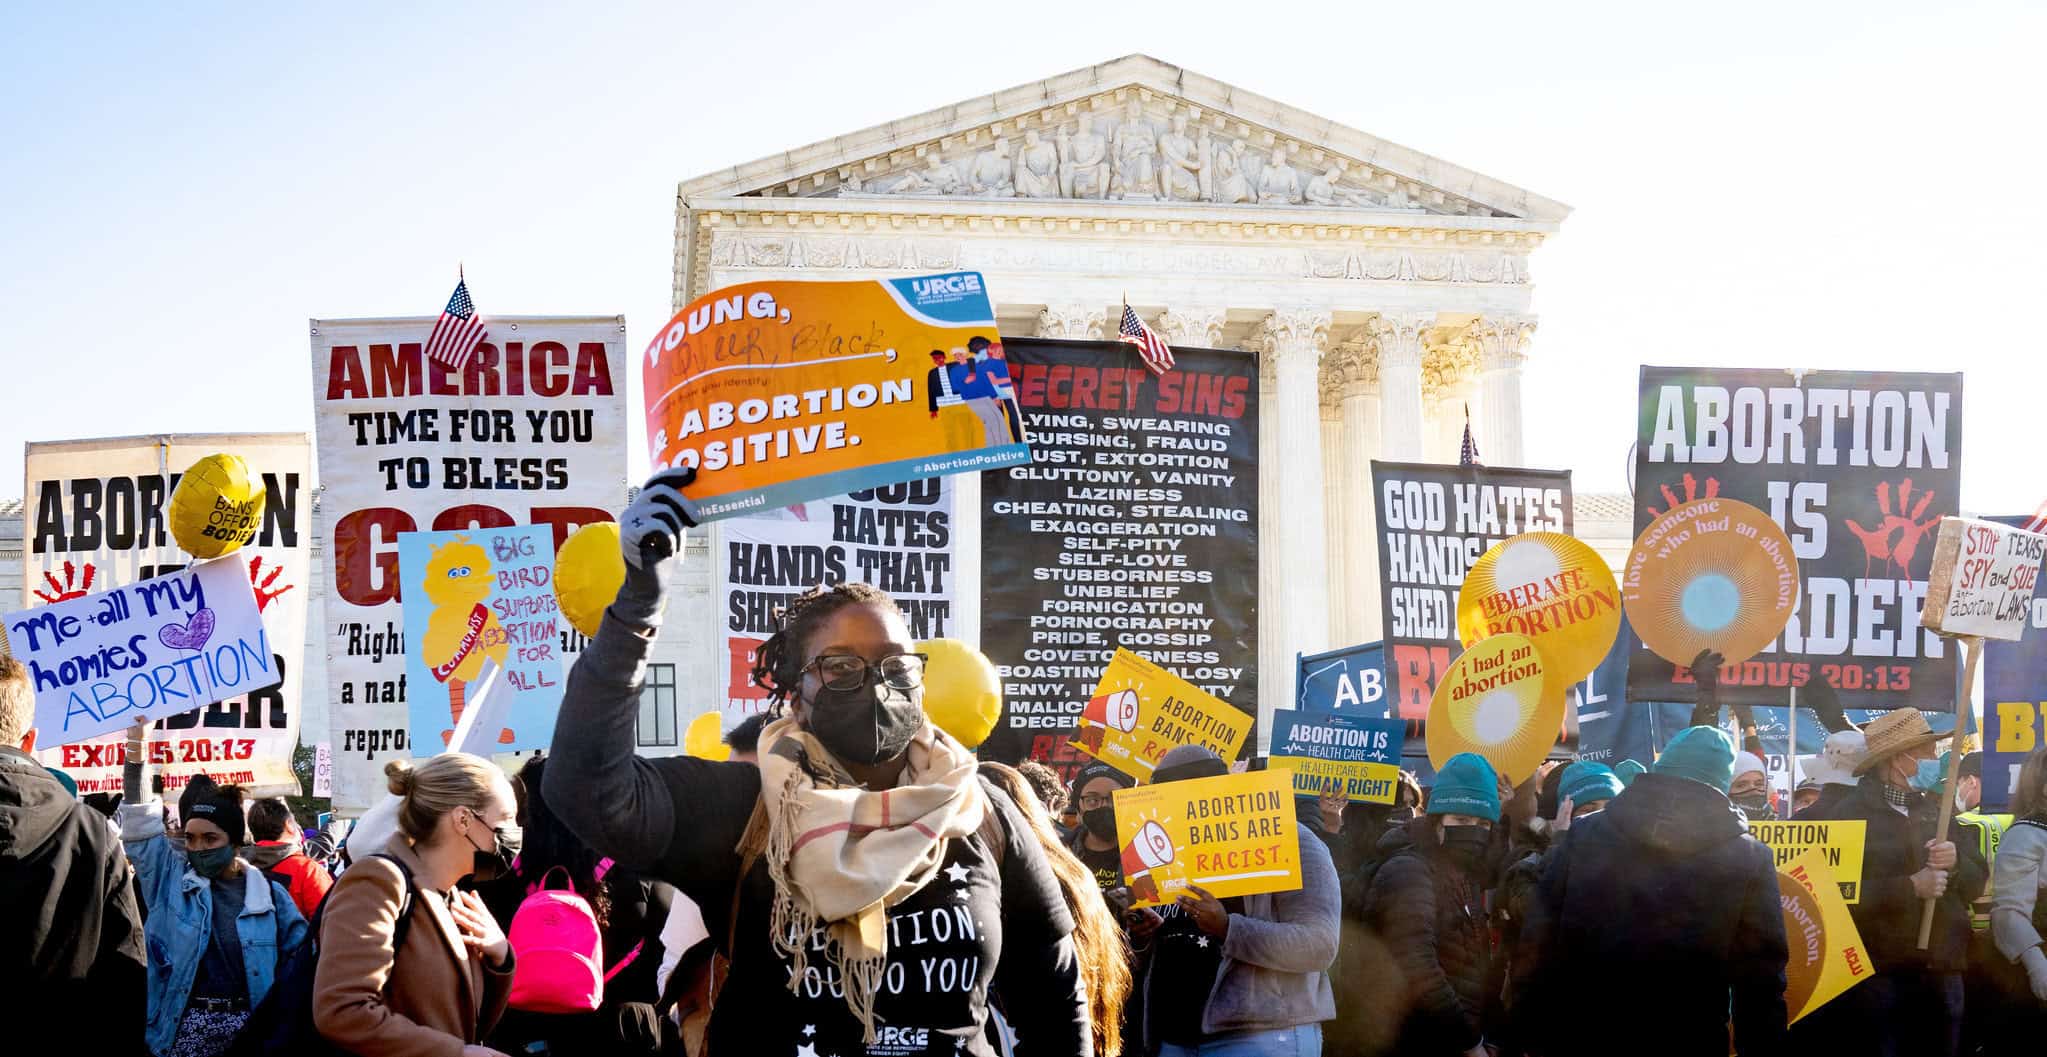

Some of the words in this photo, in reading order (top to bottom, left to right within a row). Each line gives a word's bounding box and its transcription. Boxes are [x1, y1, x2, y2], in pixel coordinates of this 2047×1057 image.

[912, 274, 981, 297] URGE
[650, 292, 793, 368] YOUNG,
[791, 320, 885, 356] Black
[678, 378, 913, 441] ABORTION
[1156, 371, 1250, 419] SINS
[349, 408, 440, 446] TIME
[449, 409, 516, 443] FOR
[526, 409, 594, 443] YOU
[1102, 417, 1231, 437] SWEARING
[1647, 385, 1950, 469] ABORTION
[655, 421, 863, 473] OSITIVE.
[1025, 432, 1137, 450] CURSING,
[1147, 436, 1228, 452] FRAUD
[379, 457, 431, 491] TO
[442, 457, 569, 490] BLESS
[913, 450, 1026, 474] #AbortionPositive
[1031, 450, 1088, 466] UST,
[1094, 452, 1230, 470] EXTORTION
[1009, 467, 1142, 486] GLUTTONY,
[1151, 471, 1236, 488] VANITY
[214, 495, 255, 515] BANS
[1067, 486, 1183, 502] LAZINESS
[1383, 479, 1447, 533] GOD
[1453, 483, 1565, 536] HATES
[33, 473, 300, 554] ABORN
[833, 503, 950, 549] HATES
[992, 501, 1124, 520] CHEATING,
[1131, 504, 1249, 523] STEALING
[1767, 481, 1828, 560] IS
[1030, 520, 1217, 538] EXAGGERATION
[1655, 529, 1691, 560] who
[1695, 516, 1730, 534] had
[1735, 521, 1758, 540] an
[1966, 525, 2001, 556] STOP
[2007, 532, 2044, 561] TEXAS
[491, 535, 535, 563] BIG
[1063, 536, 1183, 552] SELF-PITY
[1624, 552, 1648, 588] love
[1644, 500, 1720, 548] someone
[728, 541, 847, 587] HANDS
[856, 547, 951, 594] THAT
[1058, 552, 1188, 568] SELF-LOVE
[1386, 532, 1481, 586] HANDS
[497, 564, 550, 592] BIRD
[1033, 567, 1214, 584] STUBBORNESS
[1960, 558, 1995, 590] SPY
[1989, 567, 2012, 588] and
[2008, 563, 2039, 591] SUE
[1063, 584, 1181, 600] UNBELIEF
[1478, 567, 1590, 621] LIBERATE
[1995, 591, 2030, 622] LAWS
[491, 594, 558, 622] SUPPORTS
[1042, 600, 1204, 616] FORNICATION
[1390, 586, 1448, 640] SHED
[13, 612, 82, 652] Me
[470, 617, 557, 655] ABORTION
[1030, 615, 1215, 632] PORNOGRAPHY
[1032, 631, 1108, 647] PRIDE,
[1117, 632, 1213, 647] GOSSIP
[29, 634, 148, 693] homies
[517, 644, 555, 664] FOR
[1023, 649, 1221, 665] COVETOSNESS
[1461, 661, 1467, 677] i
[1473, 649, 1505, 675] had
[1511, 645, 1532, 660] an
[62, 629, 269, 733] ABORTION
[507, 670, 556, 692] ALL
[1168, 667, 1244, 681] ALOSY
[1452, 661, 1543, 701] abortion.
[1672, 661, 1811, 688] EODUS
[1820, 663, 1912, 690] 20:13
[342, 682, 354, 704] a
[1005, 683, 1071, 698] ENVY,
[1009, 700, 1086, 714] MALIC
[1160, 695, 1237, 746] ABORTION
[1288, 723, 1370, 748] ABORTION
[1372, 731, 1389, 749] IS
[181, 739, 257, 764] 20:13
[1307, 744, 1342, 759] HEALTH
[1343, 748, 1368, 761] CARE
[1300, 760, 1333, 774] HEALTH
[1335, 764, 1359, 777] CARE
[1360, 766, 1369, 778] IS
[1346, 778, 1393, 797] RIGHT
[1186, 789, 1282, 821] ABORTION
[1189, 819, 1240, 846] BANS
[1247, 816, 1284, 838] ARE
[1751, 825, 1829, 844] BORTION
[1196, 844, 1290, 873] RACIST.
[920, 956, 979, 994] YOU
[1843, 946, 1865, 977] ACLU
